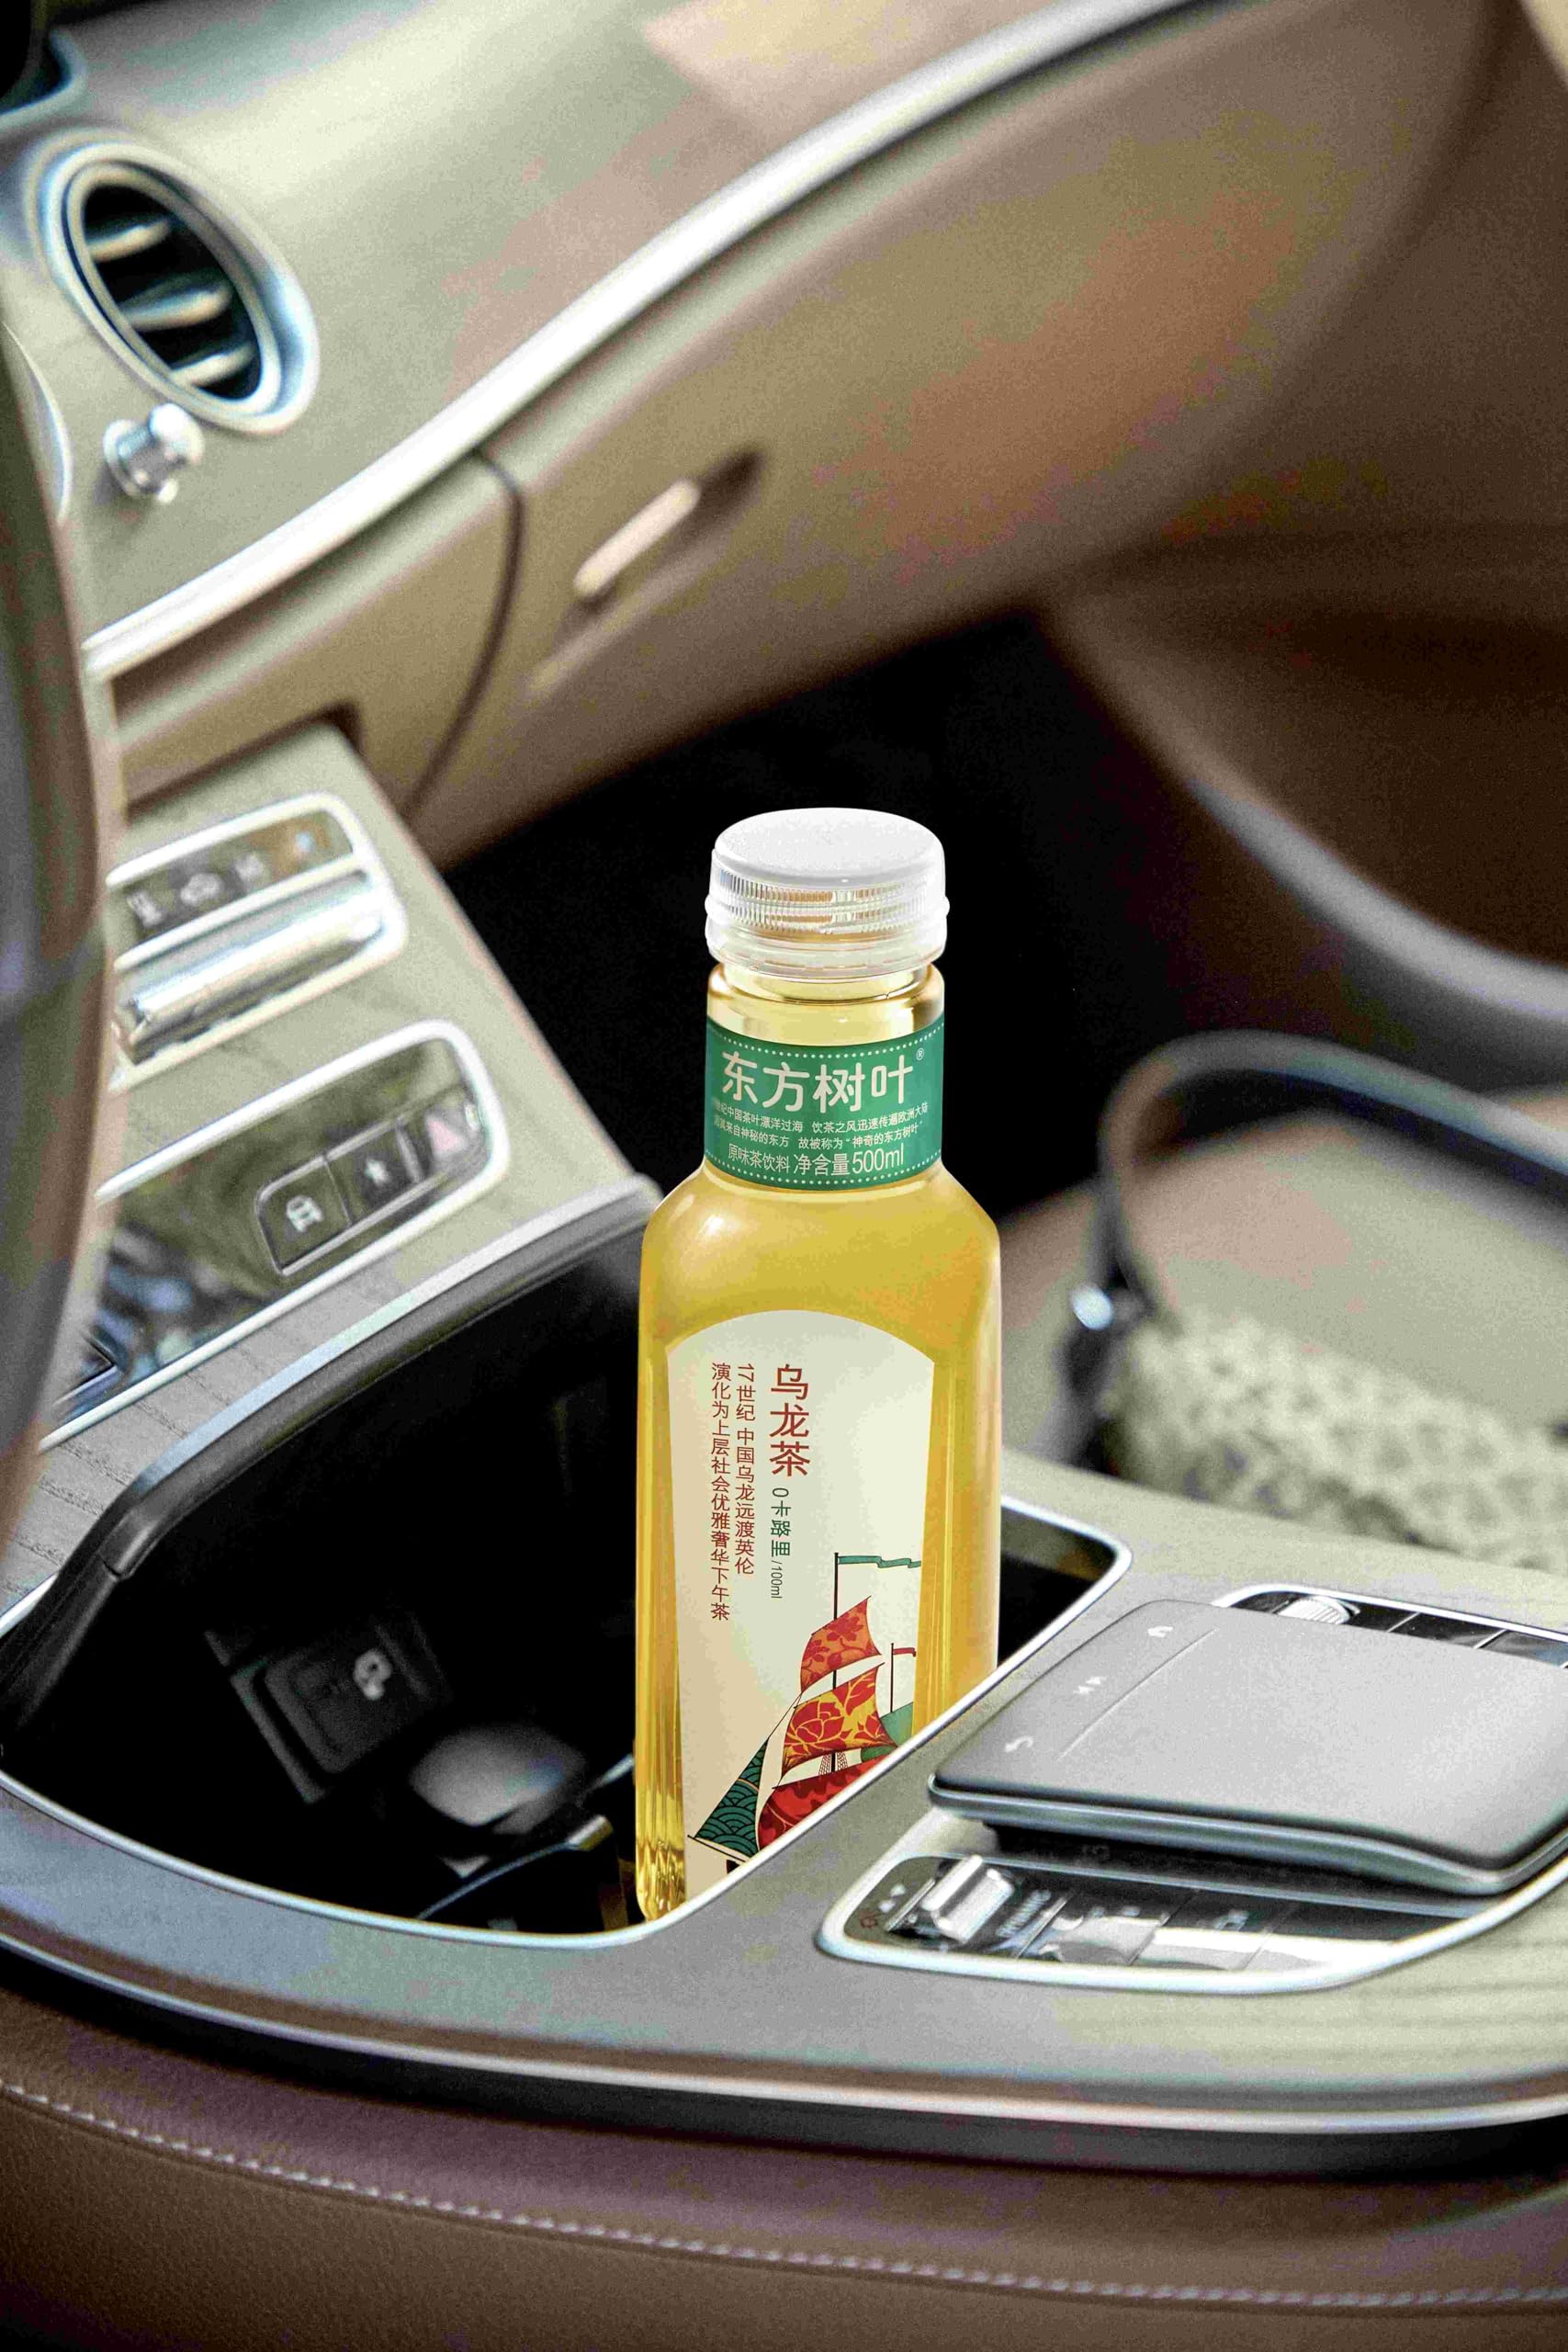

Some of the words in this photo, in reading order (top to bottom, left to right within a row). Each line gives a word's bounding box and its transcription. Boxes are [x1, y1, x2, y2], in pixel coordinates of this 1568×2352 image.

[728, 1143, 791, 1174] 原味茶饮料
[793, 1142, 905, 1177] 净含量500ml
[769, 1363, 811, 1477] 乌龙茶
[710, 1362, 732, 1622] 演化为上层社会优雅奢华下午茶
